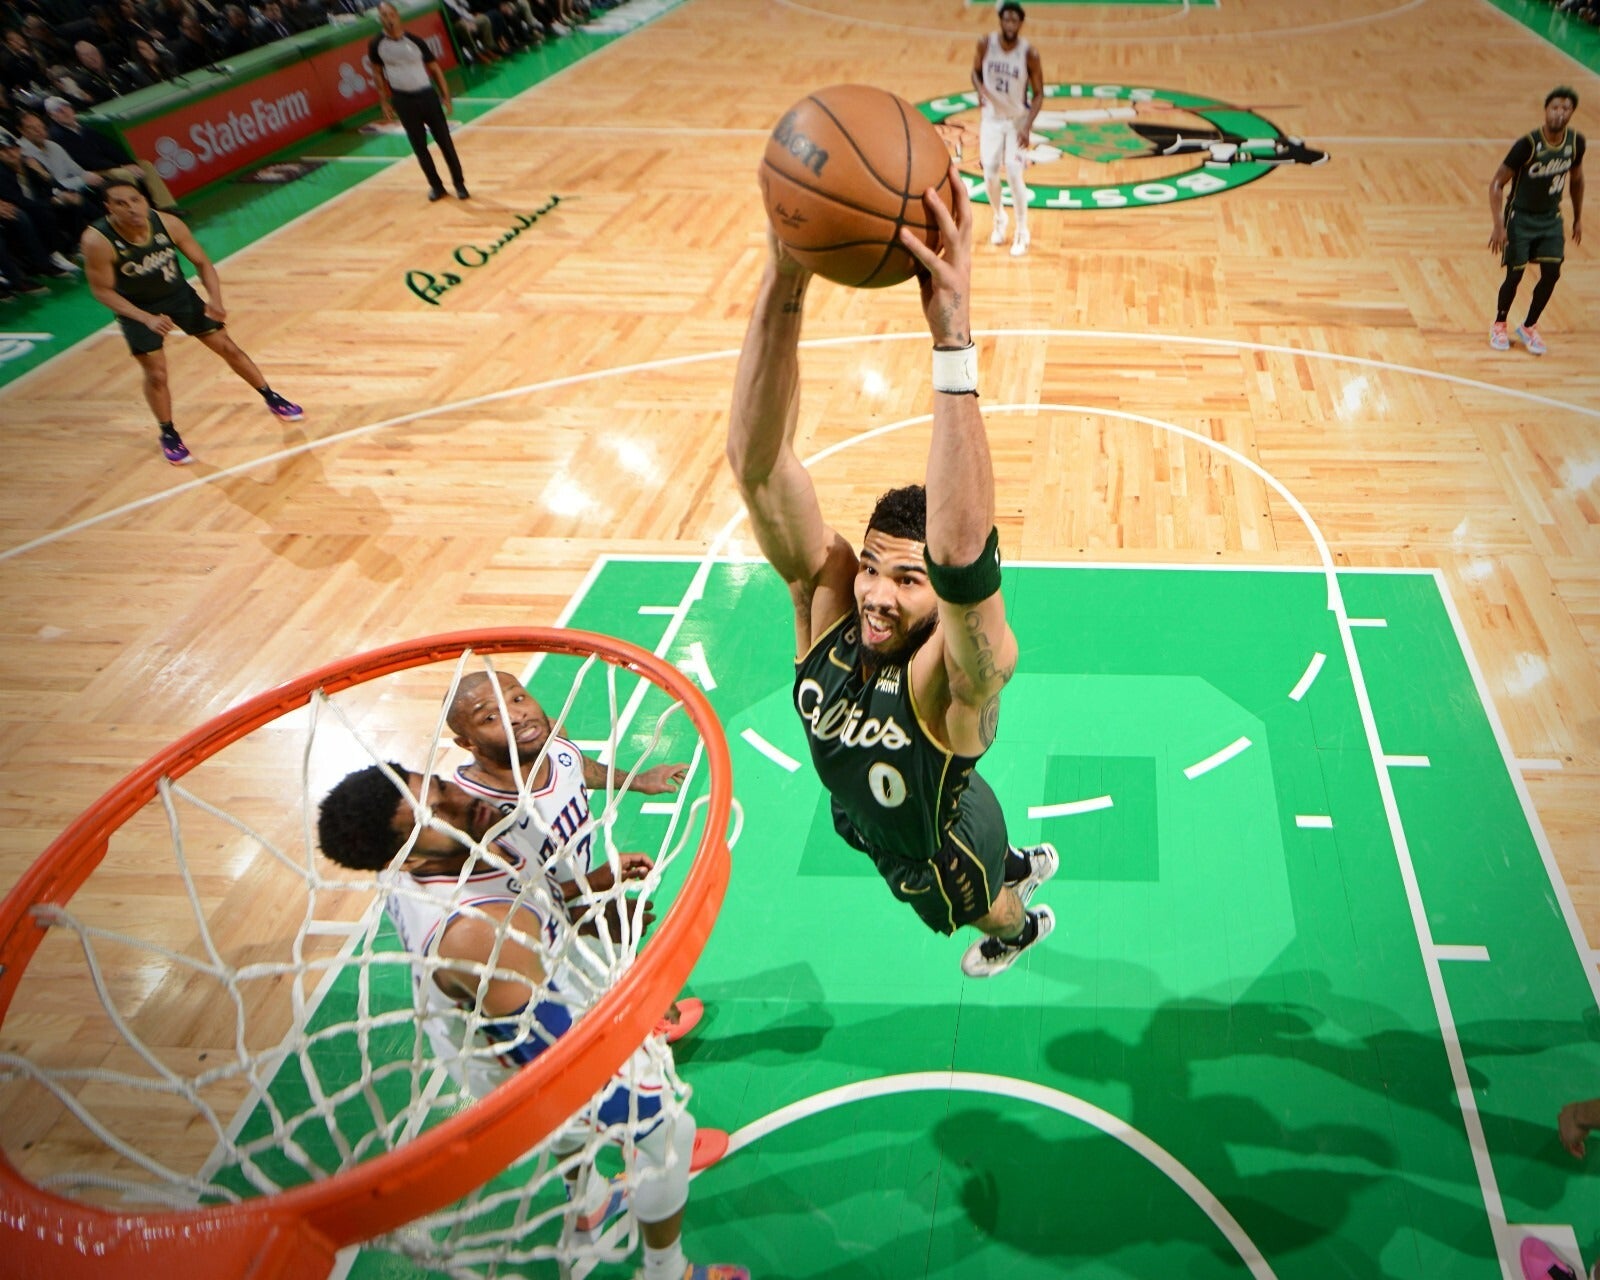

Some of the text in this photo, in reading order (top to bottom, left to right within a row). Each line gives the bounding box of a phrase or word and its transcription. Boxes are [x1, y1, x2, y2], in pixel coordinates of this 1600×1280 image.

[988, 60, 1019, 79] PHILA
[930, 84, 1155, 112] CTICS
[995, 77, 1009, 94] 21
[798, 678, 912, 750] Celtics
[868, 761, 907, 808] 0
